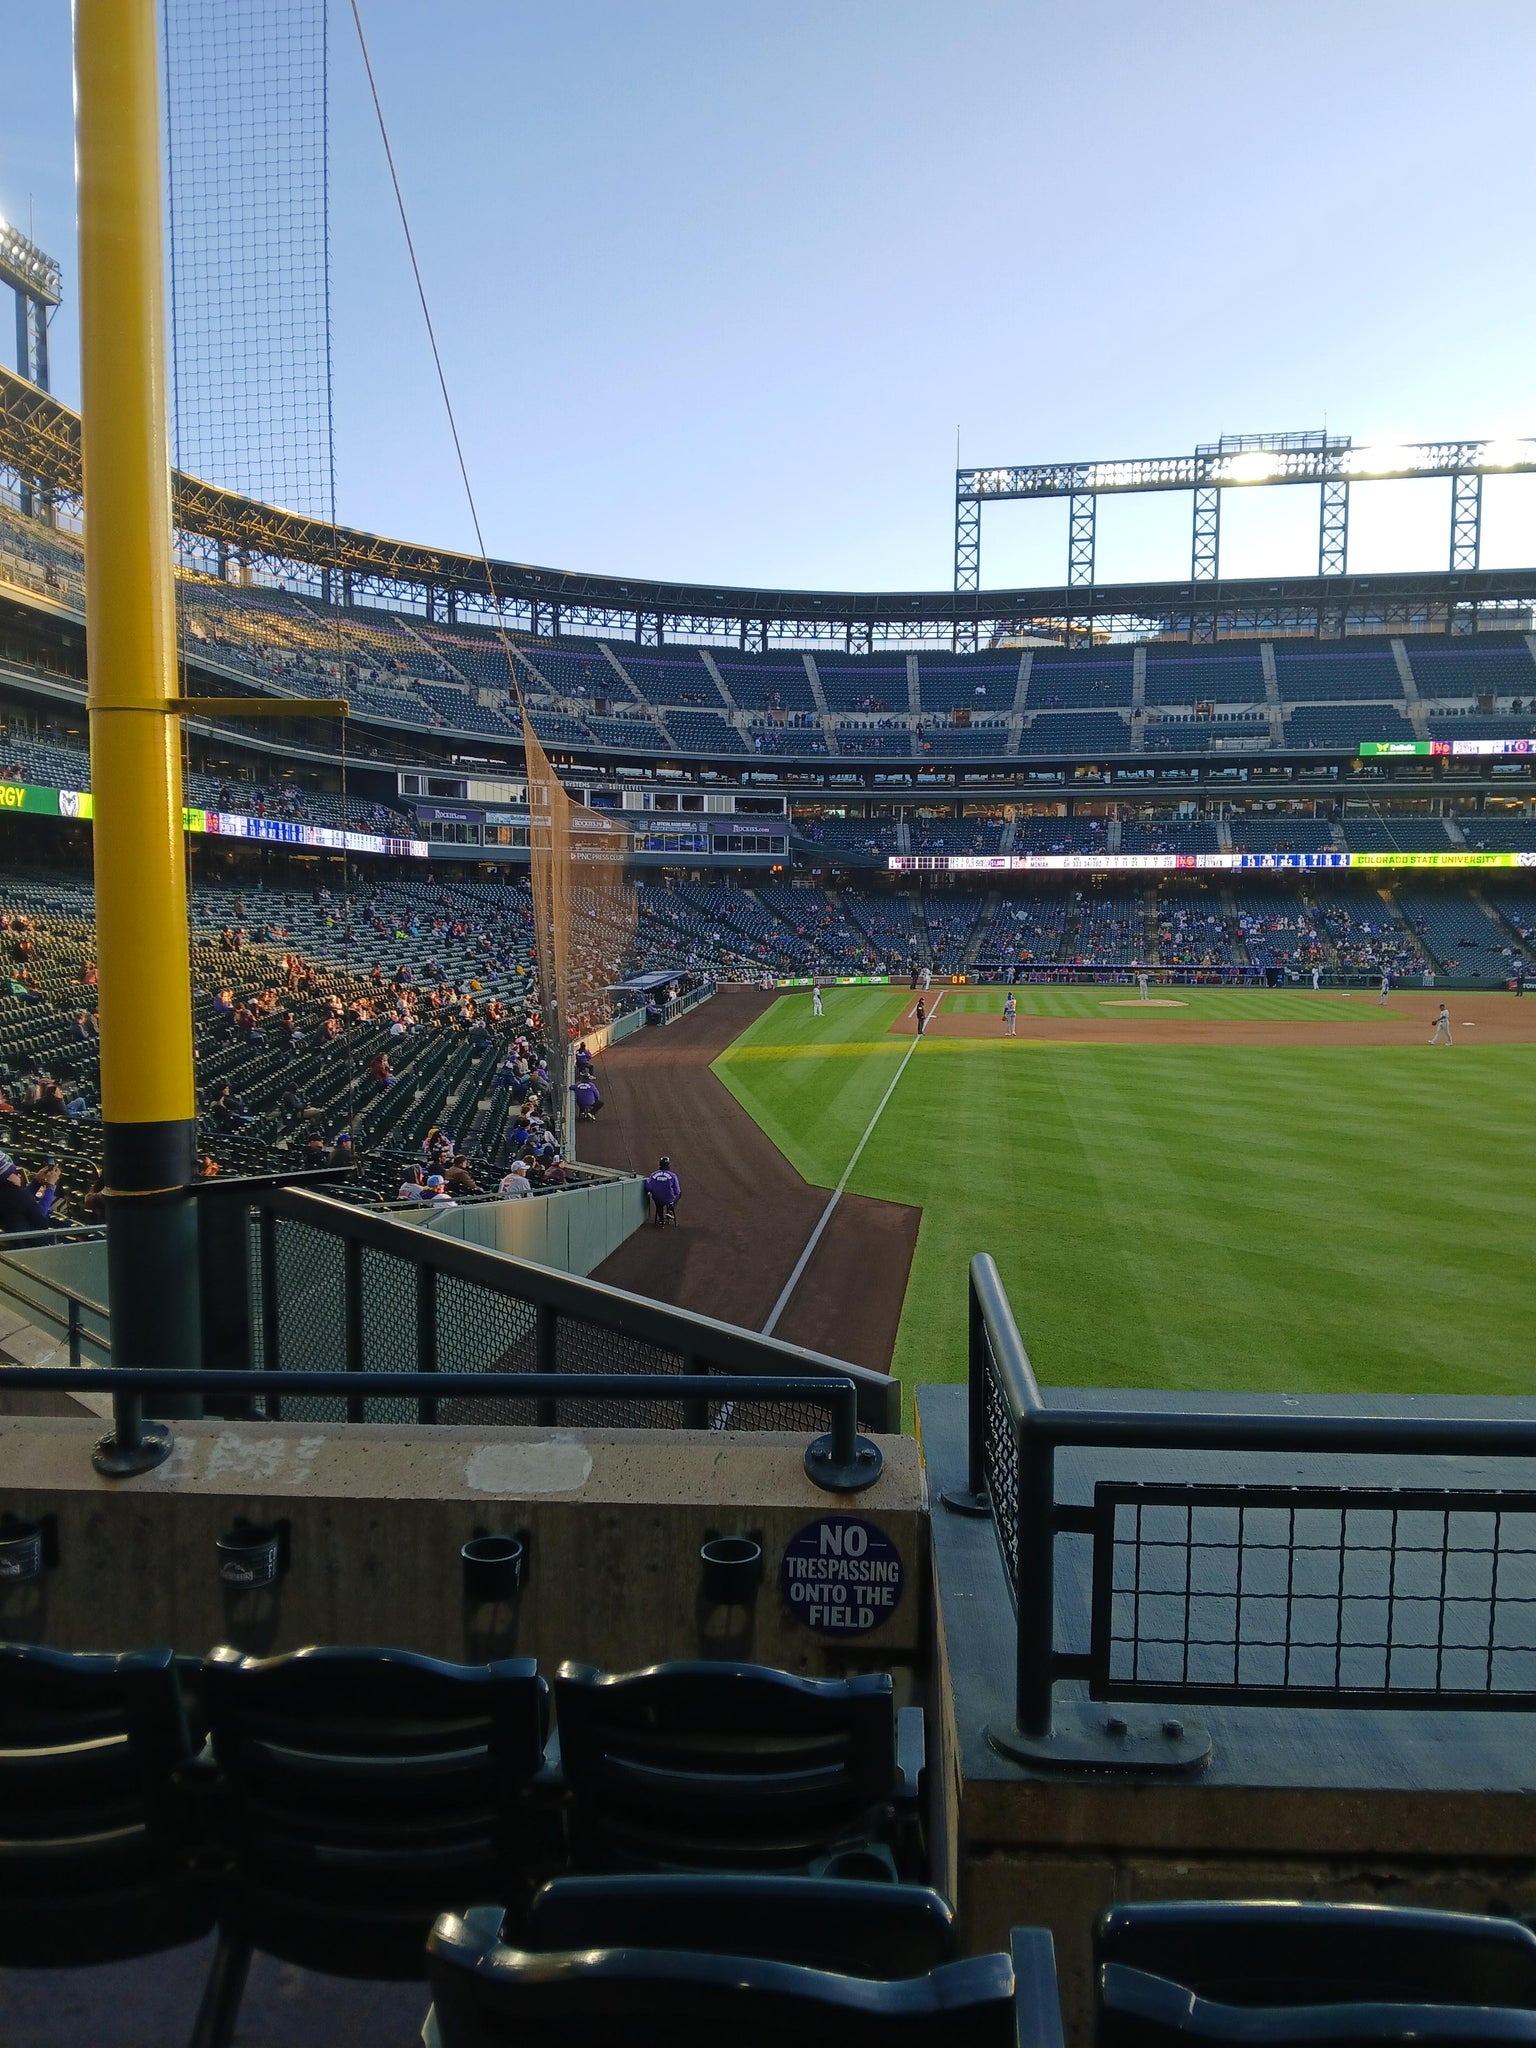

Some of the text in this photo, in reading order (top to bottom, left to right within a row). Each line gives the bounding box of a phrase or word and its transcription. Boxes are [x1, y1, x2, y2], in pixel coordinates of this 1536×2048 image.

[565, 780, 591, 789] SYSTEMS
[577, 852, 592, 861] PNC
[592, 853, 610, 861] PRESS
[1358, 855, 1497, 864] COLORADO STATE UNIVERSITY
[820, 1524, 868, 1557] NO
[786, 1557, 899, 1582] TRESPASSING
[790, 1582, 895, 1606] ONTO THE
[809, 1605, 875, 1628] FIELD
